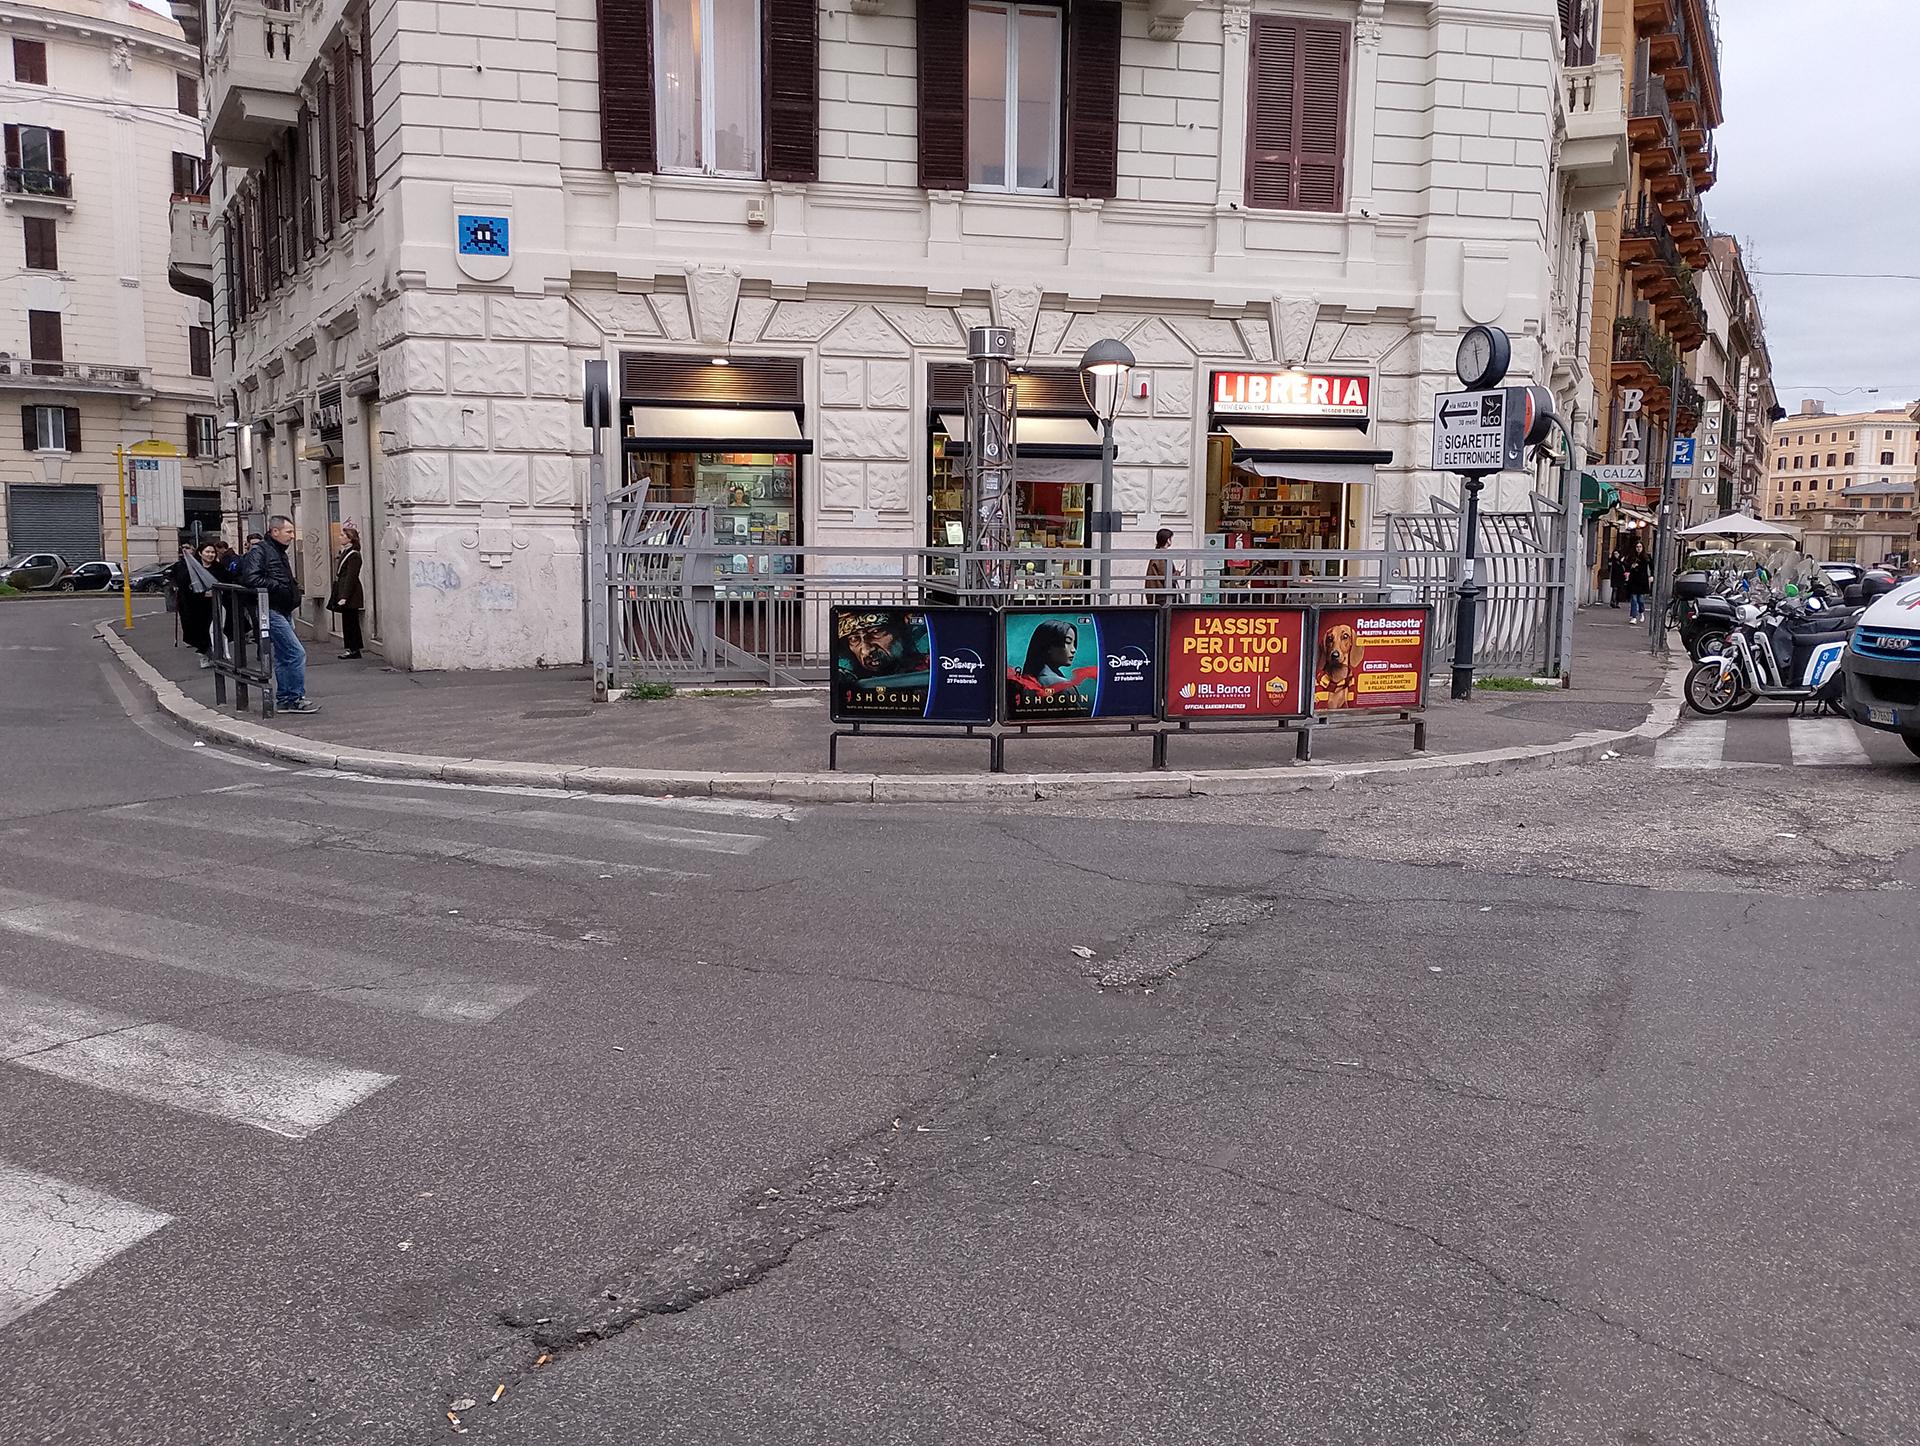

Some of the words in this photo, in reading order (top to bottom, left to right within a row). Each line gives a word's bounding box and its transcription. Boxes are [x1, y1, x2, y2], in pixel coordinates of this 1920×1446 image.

[1217, 375, 1364, 406] LIBRERIA
[1747, 367, 1761, 438] HOTEL
[1482, 415, 1501, 426] RICO
[1619, 388, 1644, 465] BAR
[1445, 433, 1501, 449] SIGARETTE
[1444, 451, 1501, 465] ELETTRONICHE
[1702, 419, 1718, 494] SAVOY
[1603, 469, 1643, 479] CALZA
[1194, 617, 1279, 635] L'ASSIST
[1183, 638, 1223, 654] PER
[1228, 638, 1235, 653] I
[1239, 637, 1288, 653] TUOI
[1876, 636, 1909, 650] IVECO
[939, 653, 985, 673] Disney+
[1106, 653, 1151, 671] Disney+
[1199, 656, 1270, 673] SOGNI!
[1198, 684, 1215, 694] IBL
[1216, 683, 1251, 694] Banca
